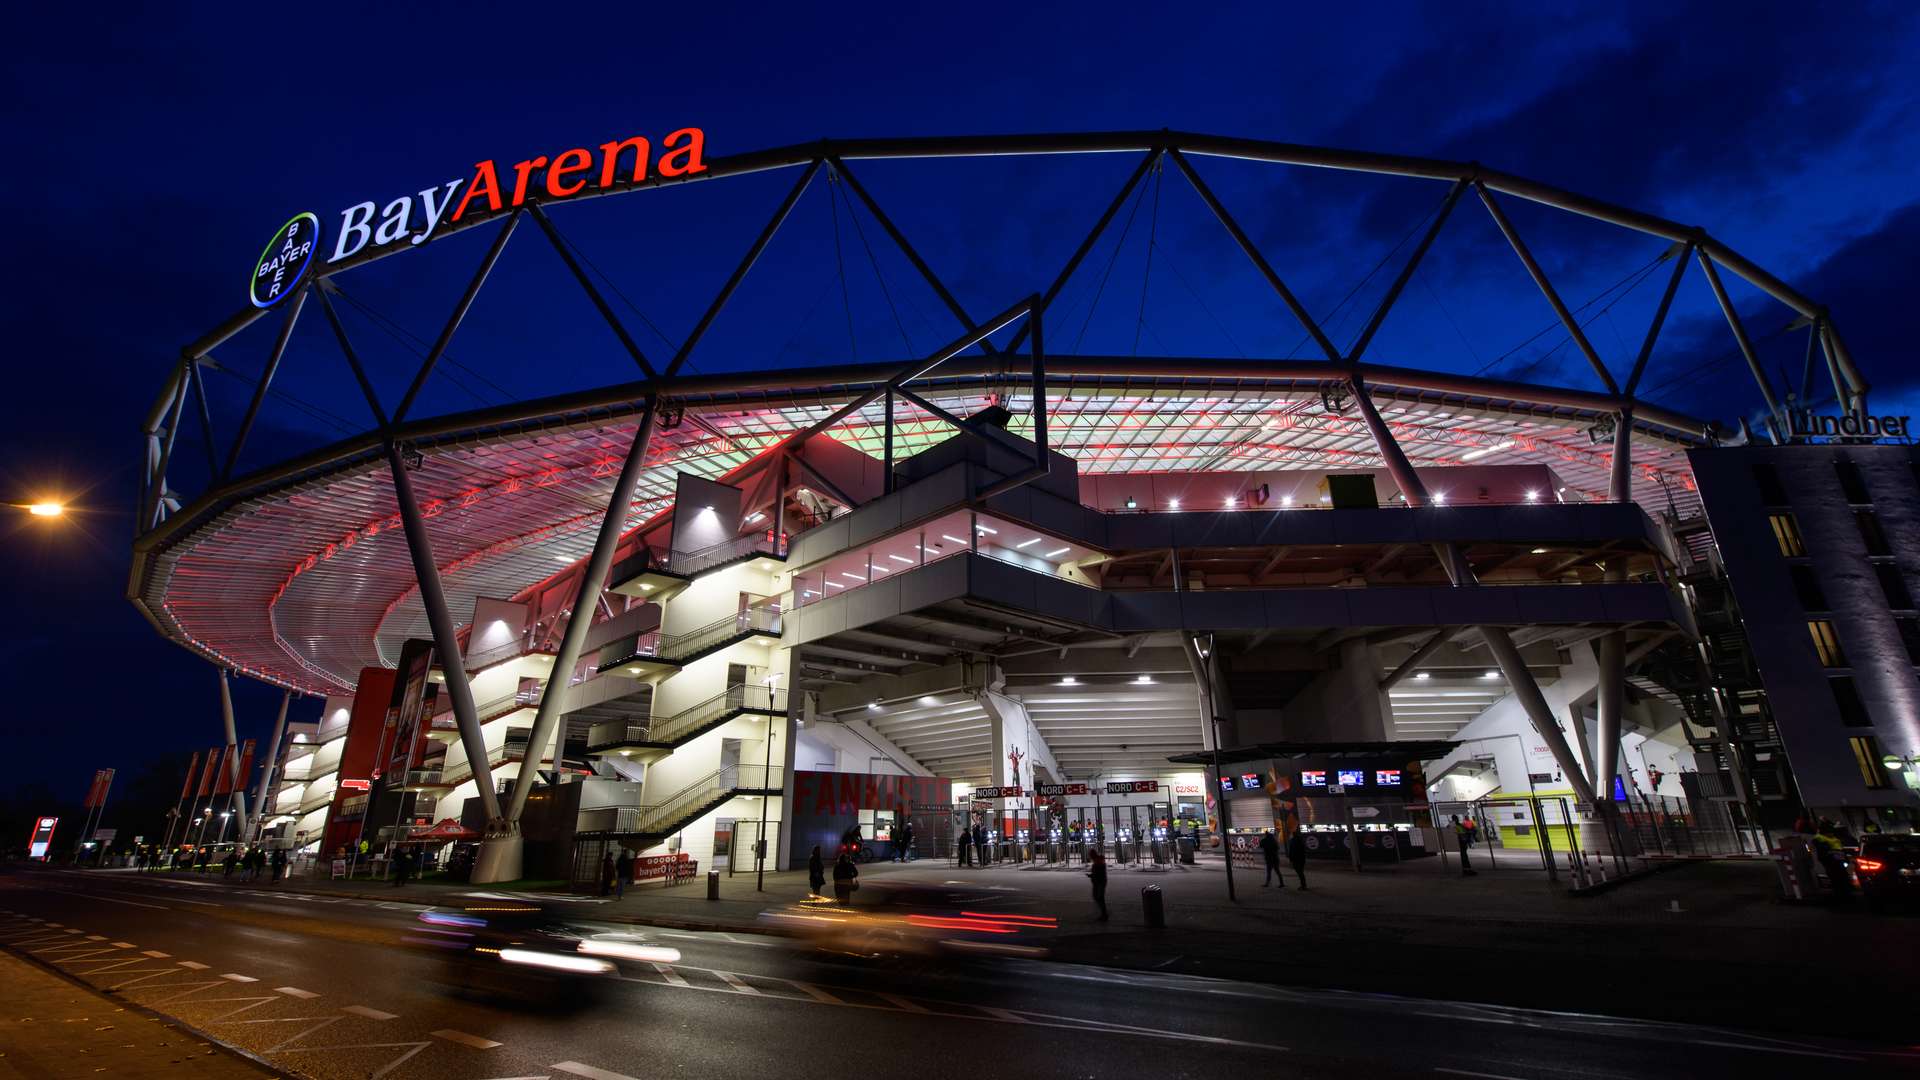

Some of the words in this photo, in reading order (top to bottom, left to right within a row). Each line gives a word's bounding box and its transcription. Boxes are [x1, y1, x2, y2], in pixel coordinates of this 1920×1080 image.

[327, 127, 708, 263] BayArena
[258, 241, 311, 277] BAYER
[269, 222, 299, 298] BAYER
[793, 771, 953, 817] FANKISTE
[977, 788, 999, 798] NORD
[1040, 786, 1064, 795] NORD
[1108, 783, 1133, 793] NORD
